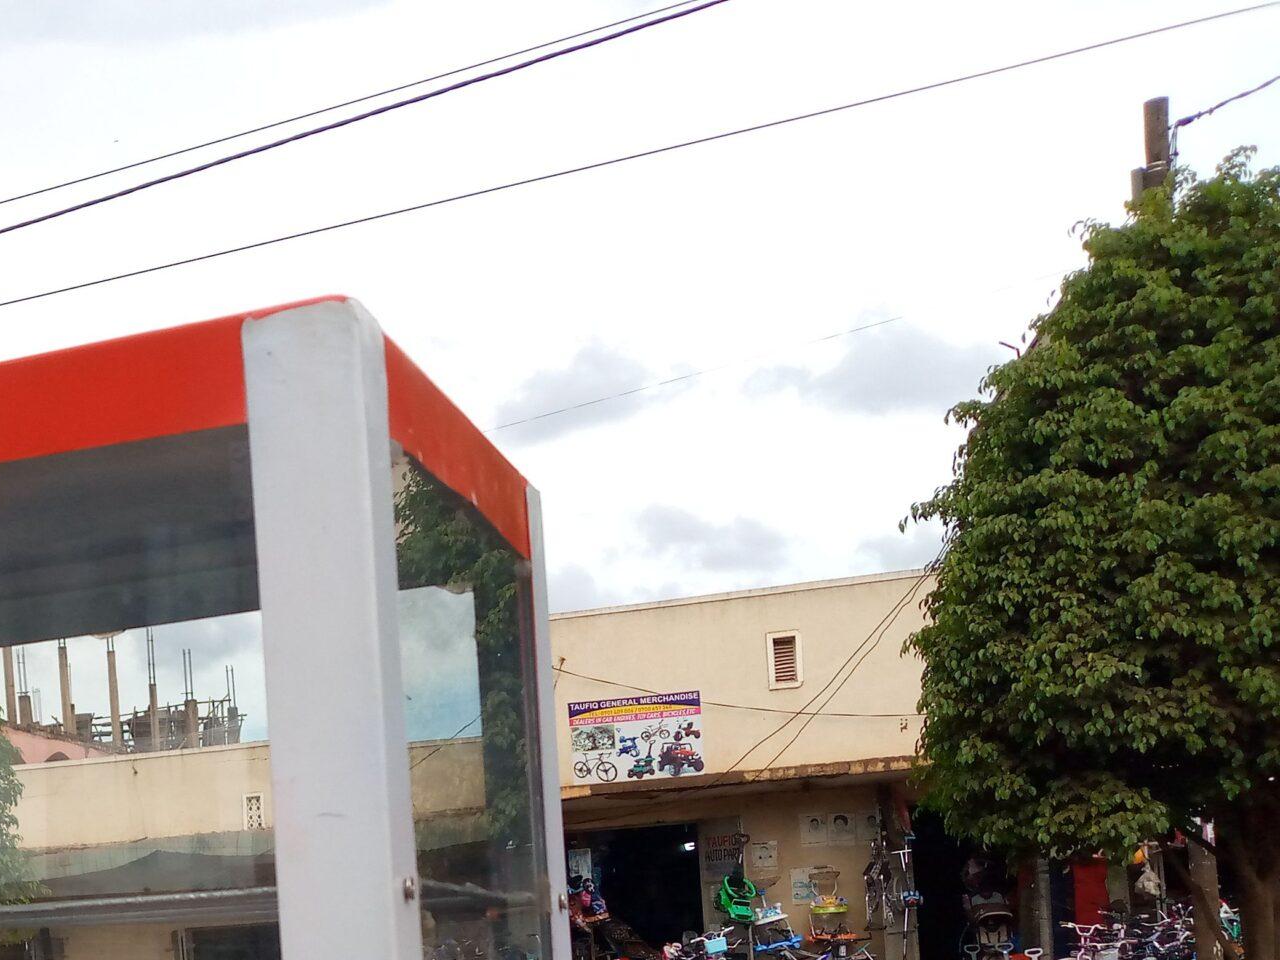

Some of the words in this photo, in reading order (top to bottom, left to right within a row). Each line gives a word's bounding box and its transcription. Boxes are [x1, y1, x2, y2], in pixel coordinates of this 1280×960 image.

[570, 702, 599, 711] TAUFIQ
[600, 698, 638, 708] GENERAL
[640, 692, 699, 704] MERCHANDISE
[723, 847, 740, 861] PART
